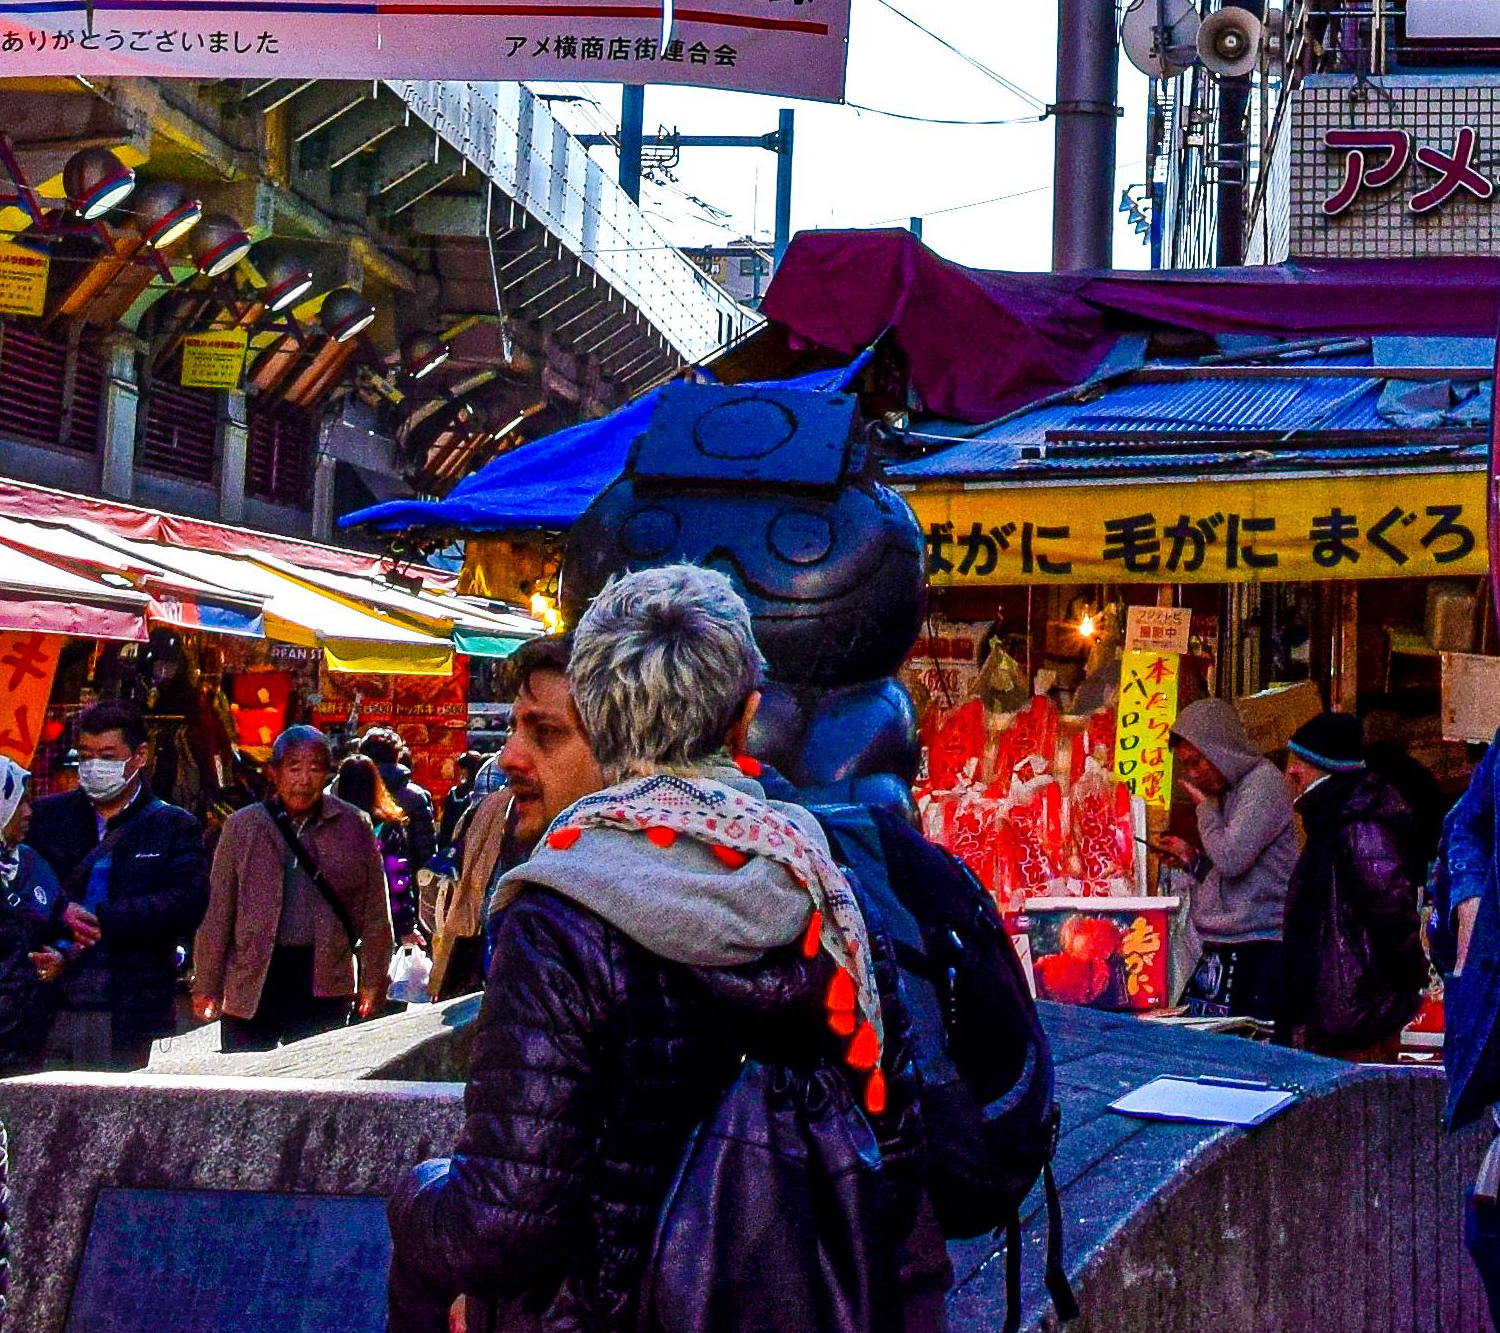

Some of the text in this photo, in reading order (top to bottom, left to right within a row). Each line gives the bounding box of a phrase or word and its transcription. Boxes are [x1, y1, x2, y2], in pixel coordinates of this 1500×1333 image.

[1, 26, 280, 56] ありがとうございました
[504, 33, 740, 69] アメ横商店街連合会
[1102, 512, 1277, 574] 毛がに
[1309, 504, 1477, 569] まぐろ
